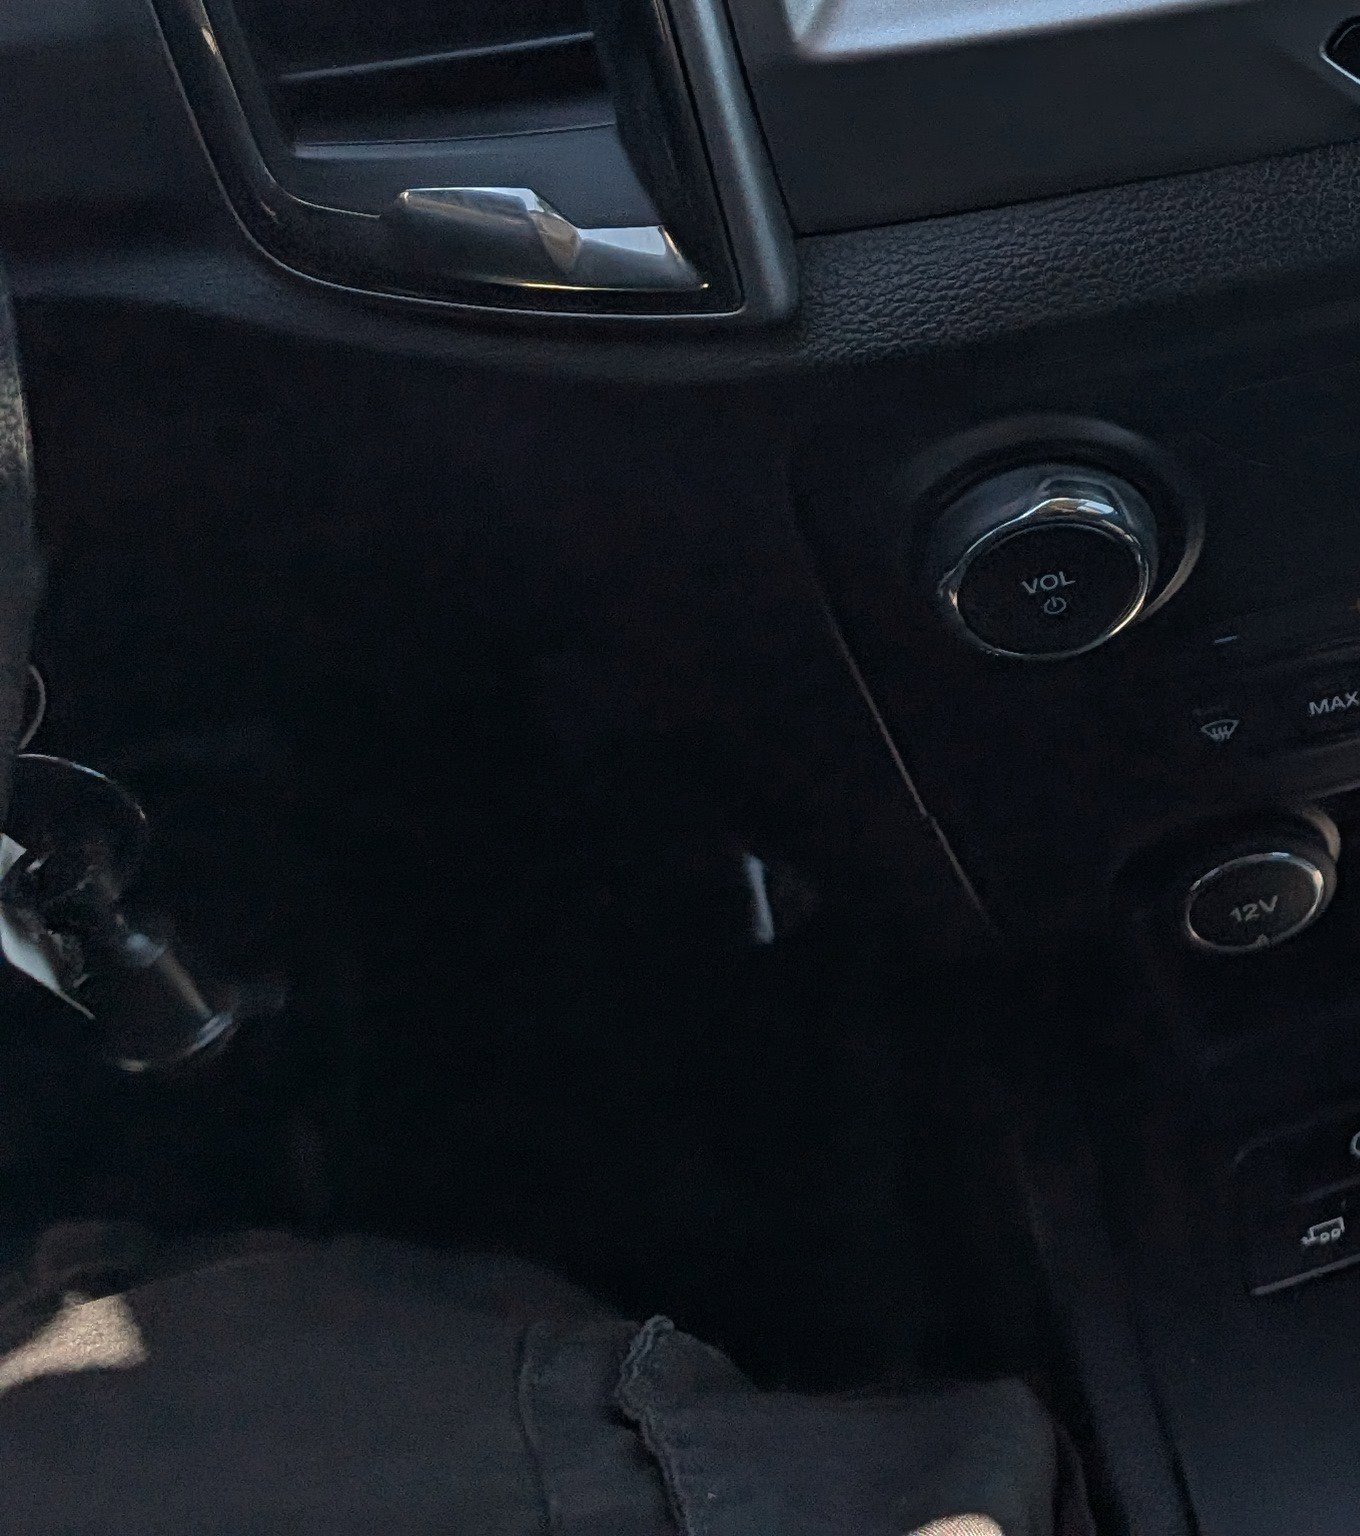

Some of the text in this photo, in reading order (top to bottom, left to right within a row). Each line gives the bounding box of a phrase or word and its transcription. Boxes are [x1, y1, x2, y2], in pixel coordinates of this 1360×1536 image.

[1020, 571, 1076, 596] VOL
[1308, 690, 1360, 717] MAX
[1229, 895, 1279, 922] 12V
